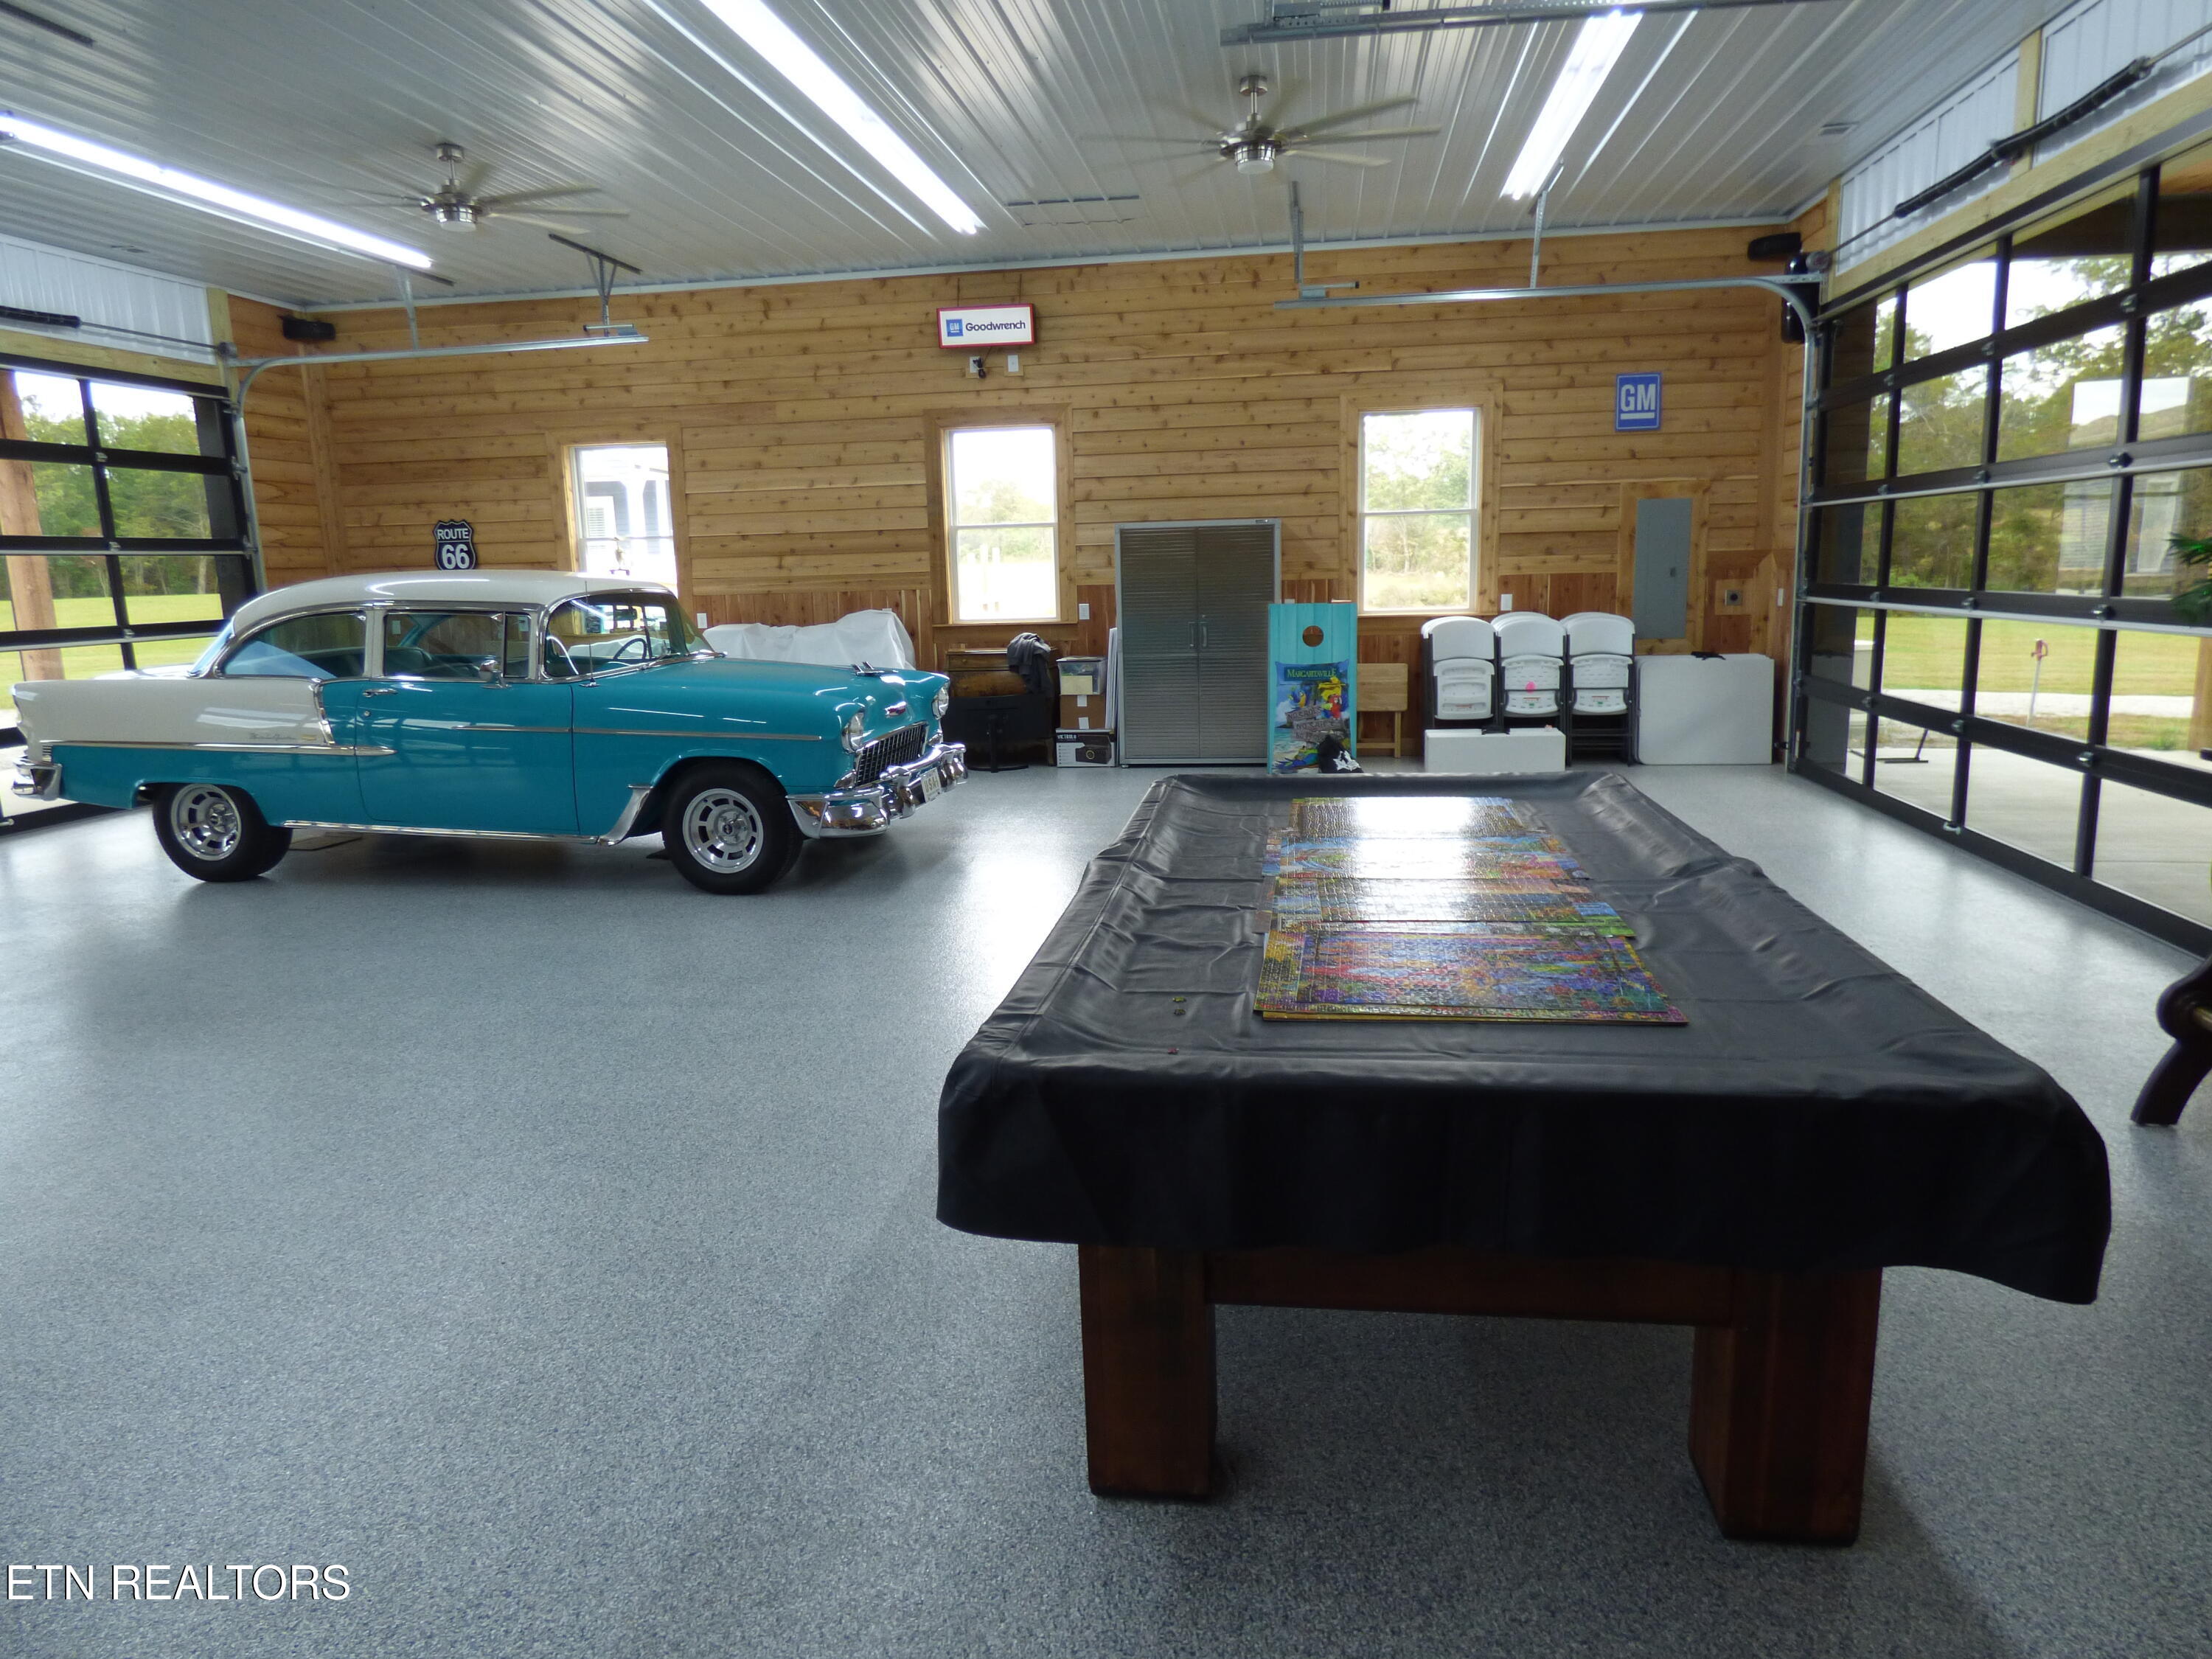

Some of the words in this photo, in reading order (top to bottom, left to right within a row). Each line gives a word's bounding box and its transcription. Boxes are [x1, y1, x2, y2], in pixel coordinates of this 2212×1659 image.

[965, 320, 1026, 332] Goodwrench
[1621, 383, 1656, 411] GM
[437, 528, 469, 540] ROUTE
[442, 543, 470, 569] 66
